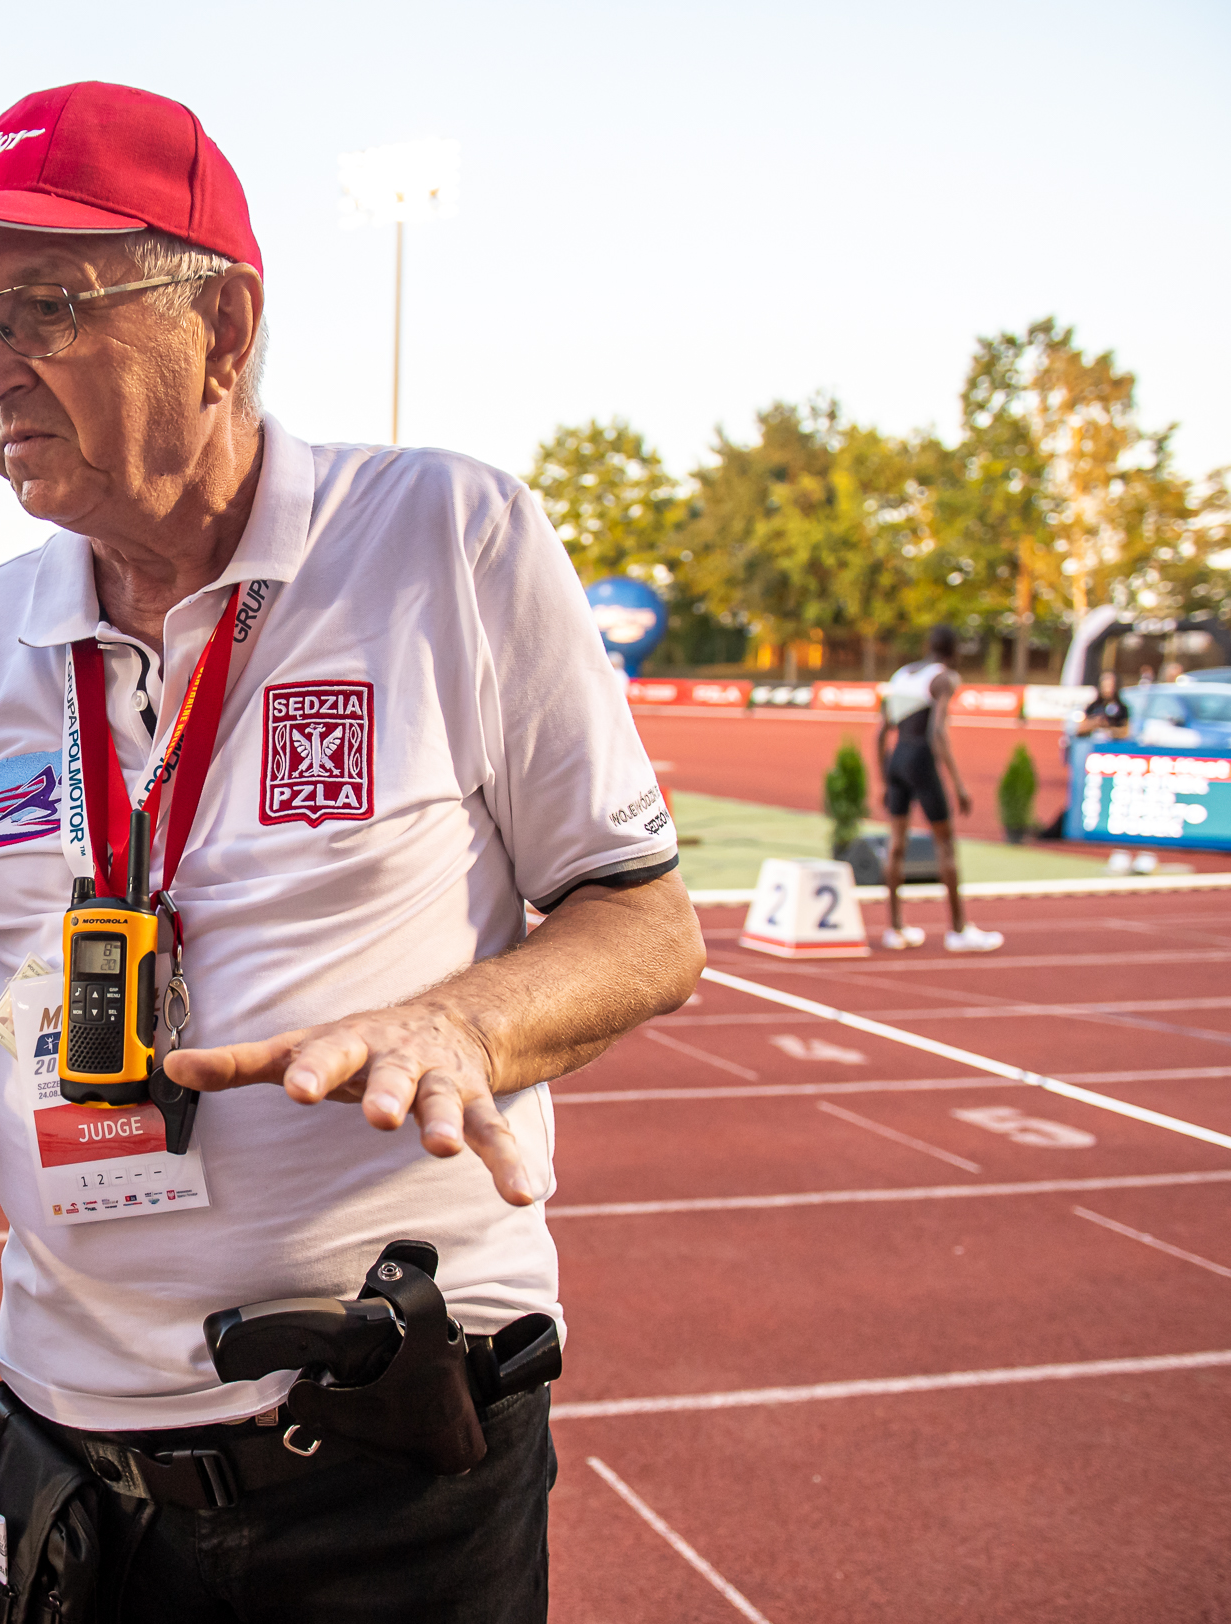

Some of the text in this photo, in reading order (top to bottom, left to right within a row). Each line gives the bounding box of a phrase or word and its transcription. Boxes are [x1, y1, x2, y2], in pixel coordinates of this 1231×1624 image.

[273, 694, 363, 720] SĘDZIA
[68, 729, 85, 844] POLMOTOR
[272, 783, 361, 811] PZLA
[814, 884, 842, 930] 2
[34, 1057, 57, 1076] 20
[37, 1080, 61, 1091] SZCZE
[77, 1116, 144, 1143] JUDGE
